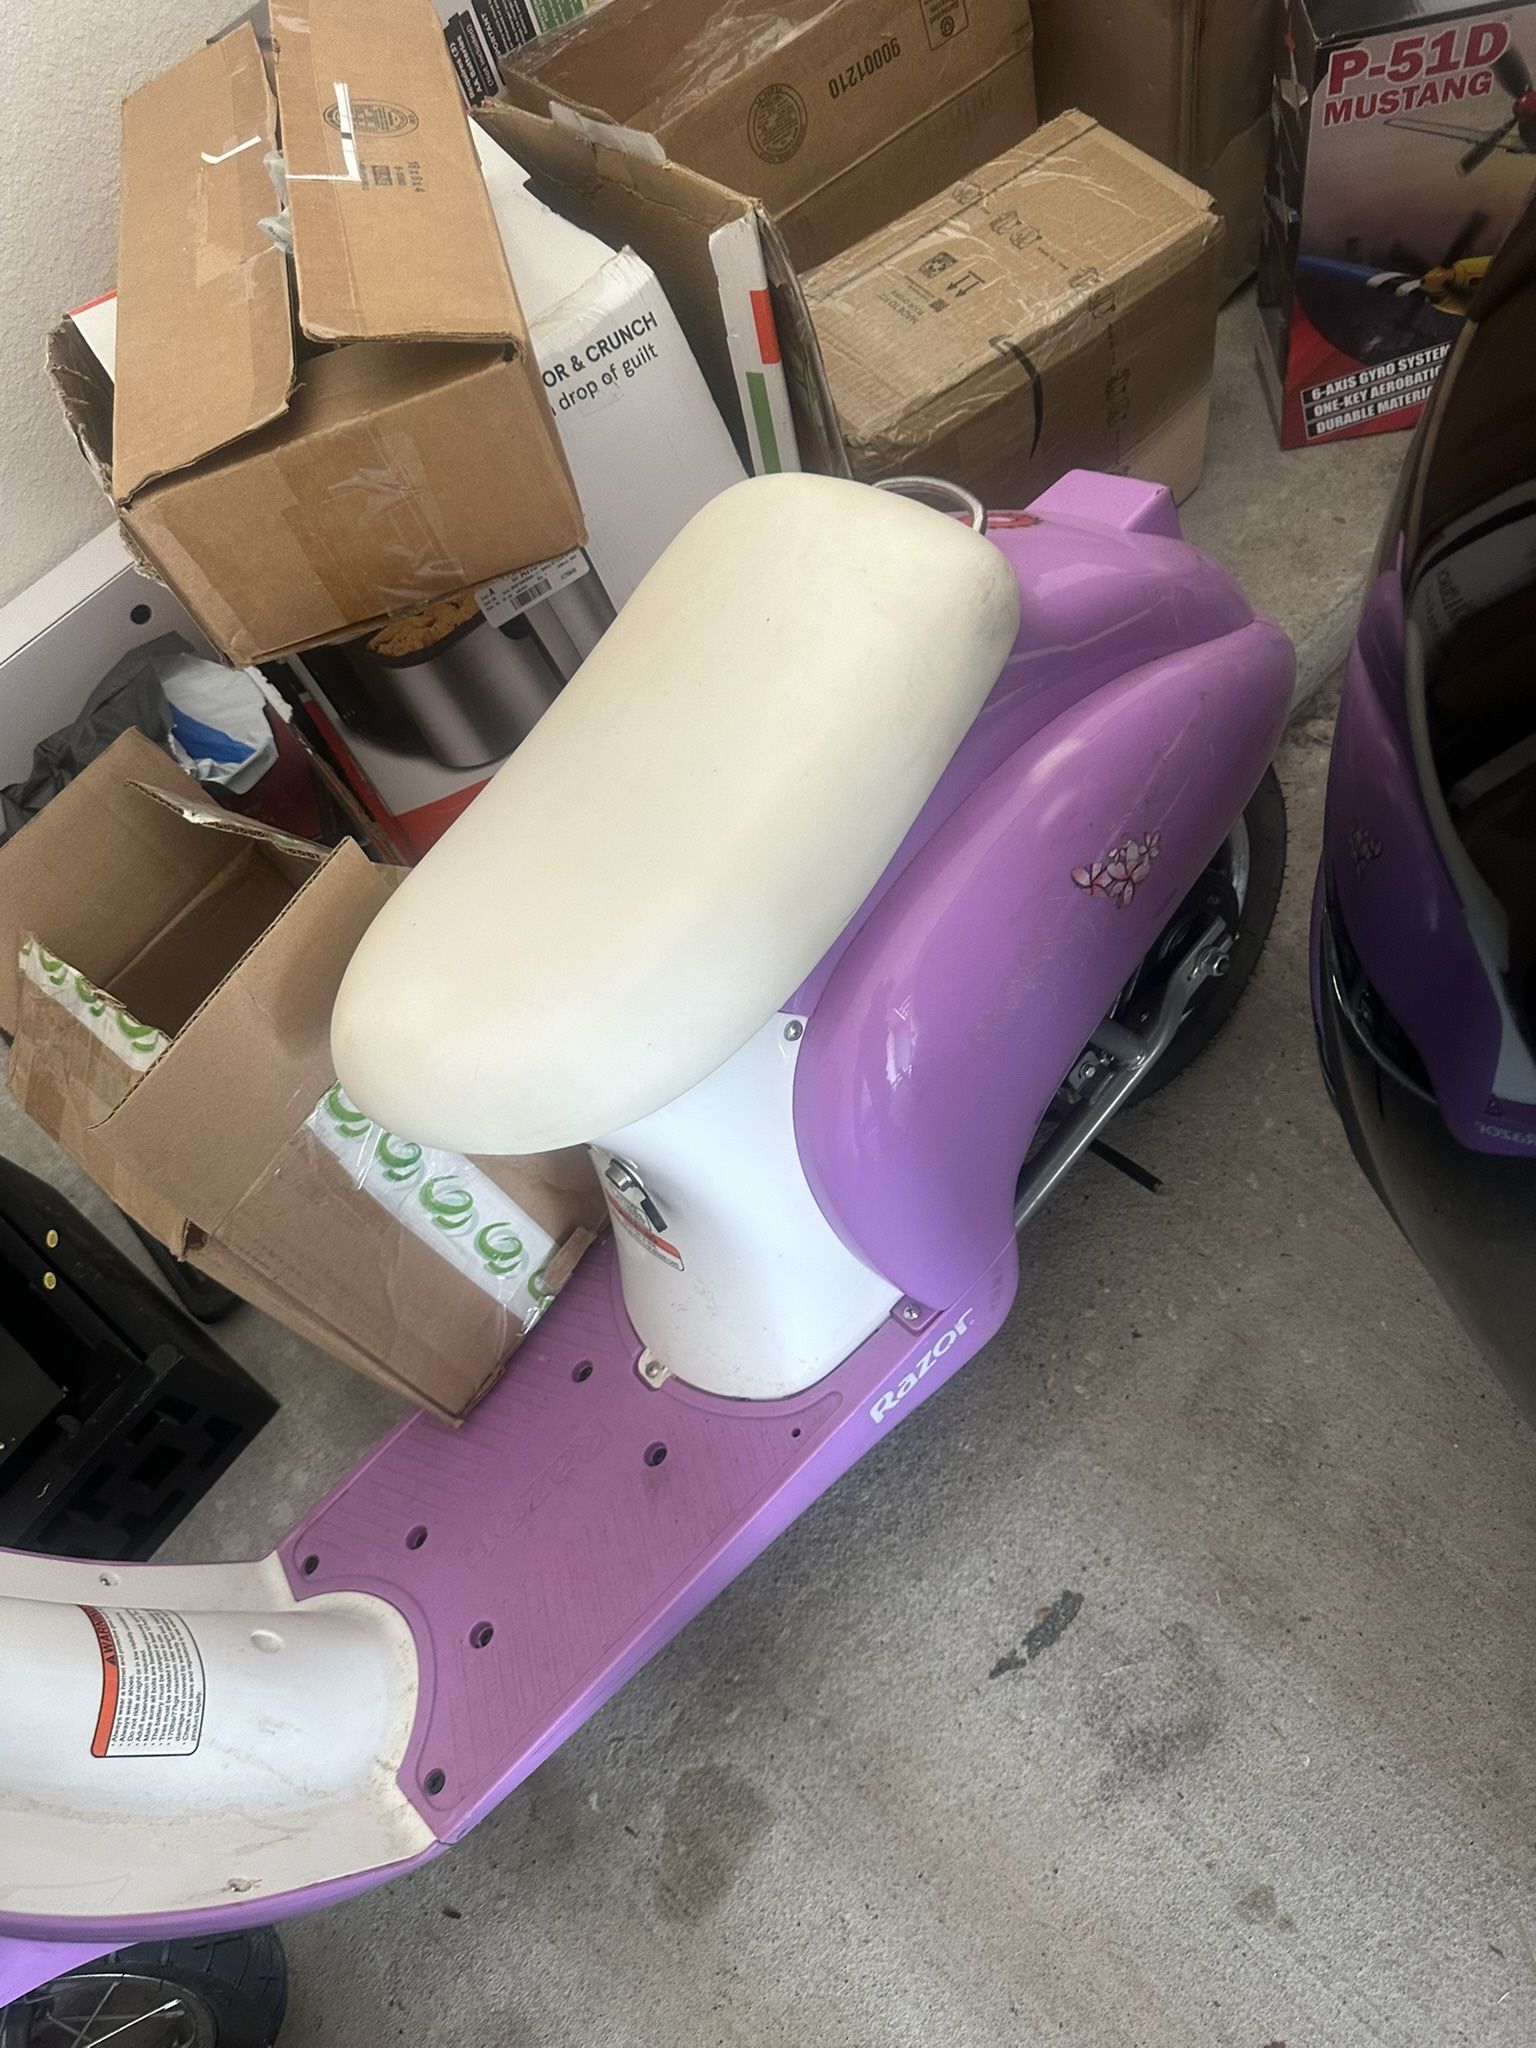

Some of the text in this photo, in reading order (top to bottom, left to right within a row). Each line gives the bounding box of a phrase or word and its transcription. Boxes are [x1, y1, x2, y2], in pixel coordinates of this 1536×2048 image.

[457, 34, 483, 93] AA Batteries
[828, 37, 901, 99] 90001210
[1328, 21, 1508, 95] P-51D
[1323, 70, 1493, 127] MUSTANG
[570, 355, 586, 372] &
[586, 311, 658, 362] CRUNCH
[559, 342, 658, 410] drop of guilt
[1311, 375, 1357, 401] 6-AXIS
[1359, 362, 1395, 384] GYRO
[1313, 391, 1367, 417] ONE-KEY
[1316, 403, 1375, 434] DURABLE
[868, 1306, 974, 1425] Razor
[155, 1650, 163, 1673] charged
[158, 1674, 164, 1682] be
[165, 1695, 171, 1703] be
[135, 1724, 144, 1742] Adult
[141, 1683, 149, 1722] supervision
[155, 1702, 164, 1726] battery
[163, 1705, 171, 1722] must
[112, 1717, 122, 1742] Always
[120, 1717, 130, 1742] Always
[128, 1731, 135, 1741] Do
[143, 1722, 152, 1741] Make
[151, 1728, 159, 1741] The
[158, 1724, 167, 1741] Tires
[176, 1713, 185, 1741] damage
[182, 1719, 192, 1741] Check
[191, 1715, 199, 1741] product
